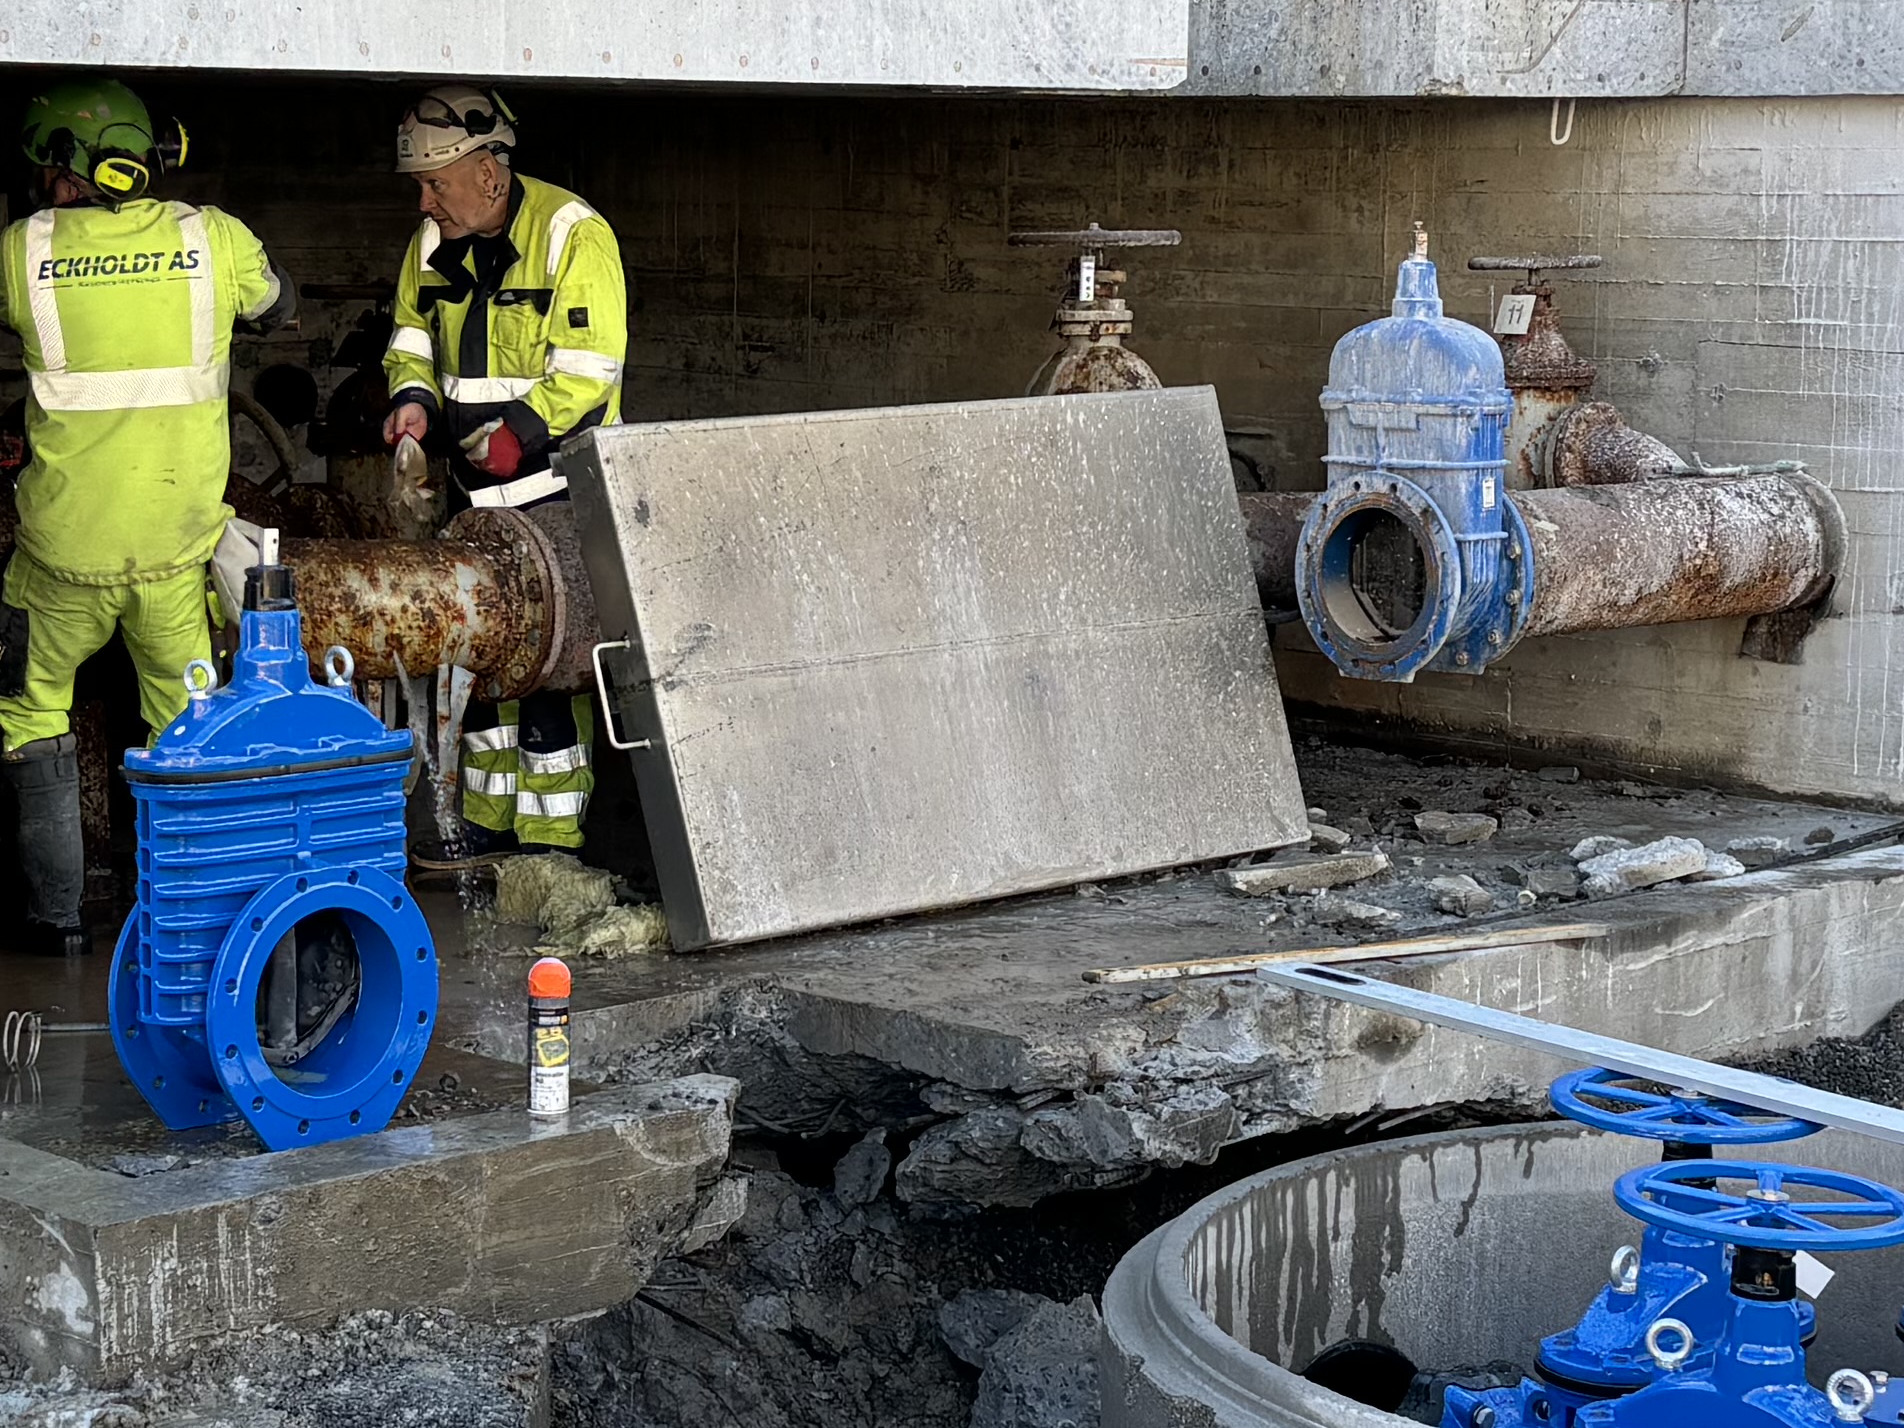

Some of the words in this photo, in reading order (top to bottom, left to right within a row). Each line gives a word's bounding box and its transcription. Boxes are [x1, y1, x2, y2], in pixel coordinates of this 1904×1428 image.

[37, 252, 165, 281] ECKHOLDT
[168, 249, 200, 271] AS
[1508, 304, 1525, 325] 11
